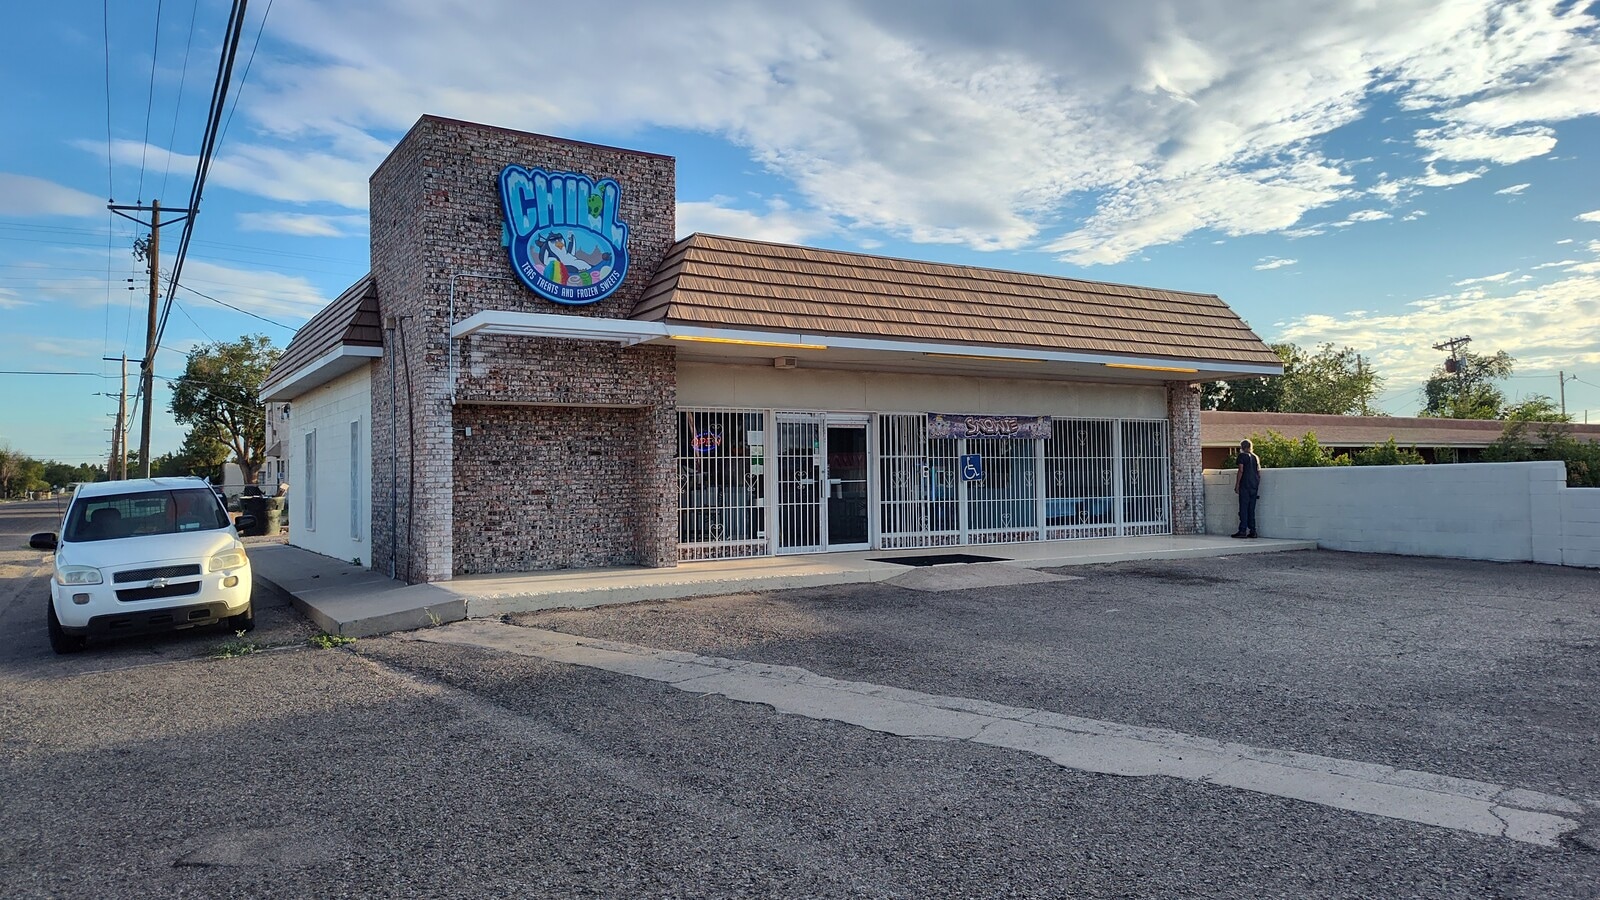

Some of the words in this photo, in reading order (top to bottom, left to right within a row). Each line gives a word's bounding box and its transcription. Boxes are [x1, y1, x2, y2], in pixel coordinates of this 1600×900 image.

[506, 170, 624, 250] CHILL
[521, 261, 537, 280] TEAS
[536, 276, 559, 295] TREATS
[561, 287, 574, 298] AND
[577, 287, 599, 298] FROZEN
[600, 269, 620, 292] SWEETS
[690, 435, 722, 447] OPEN
